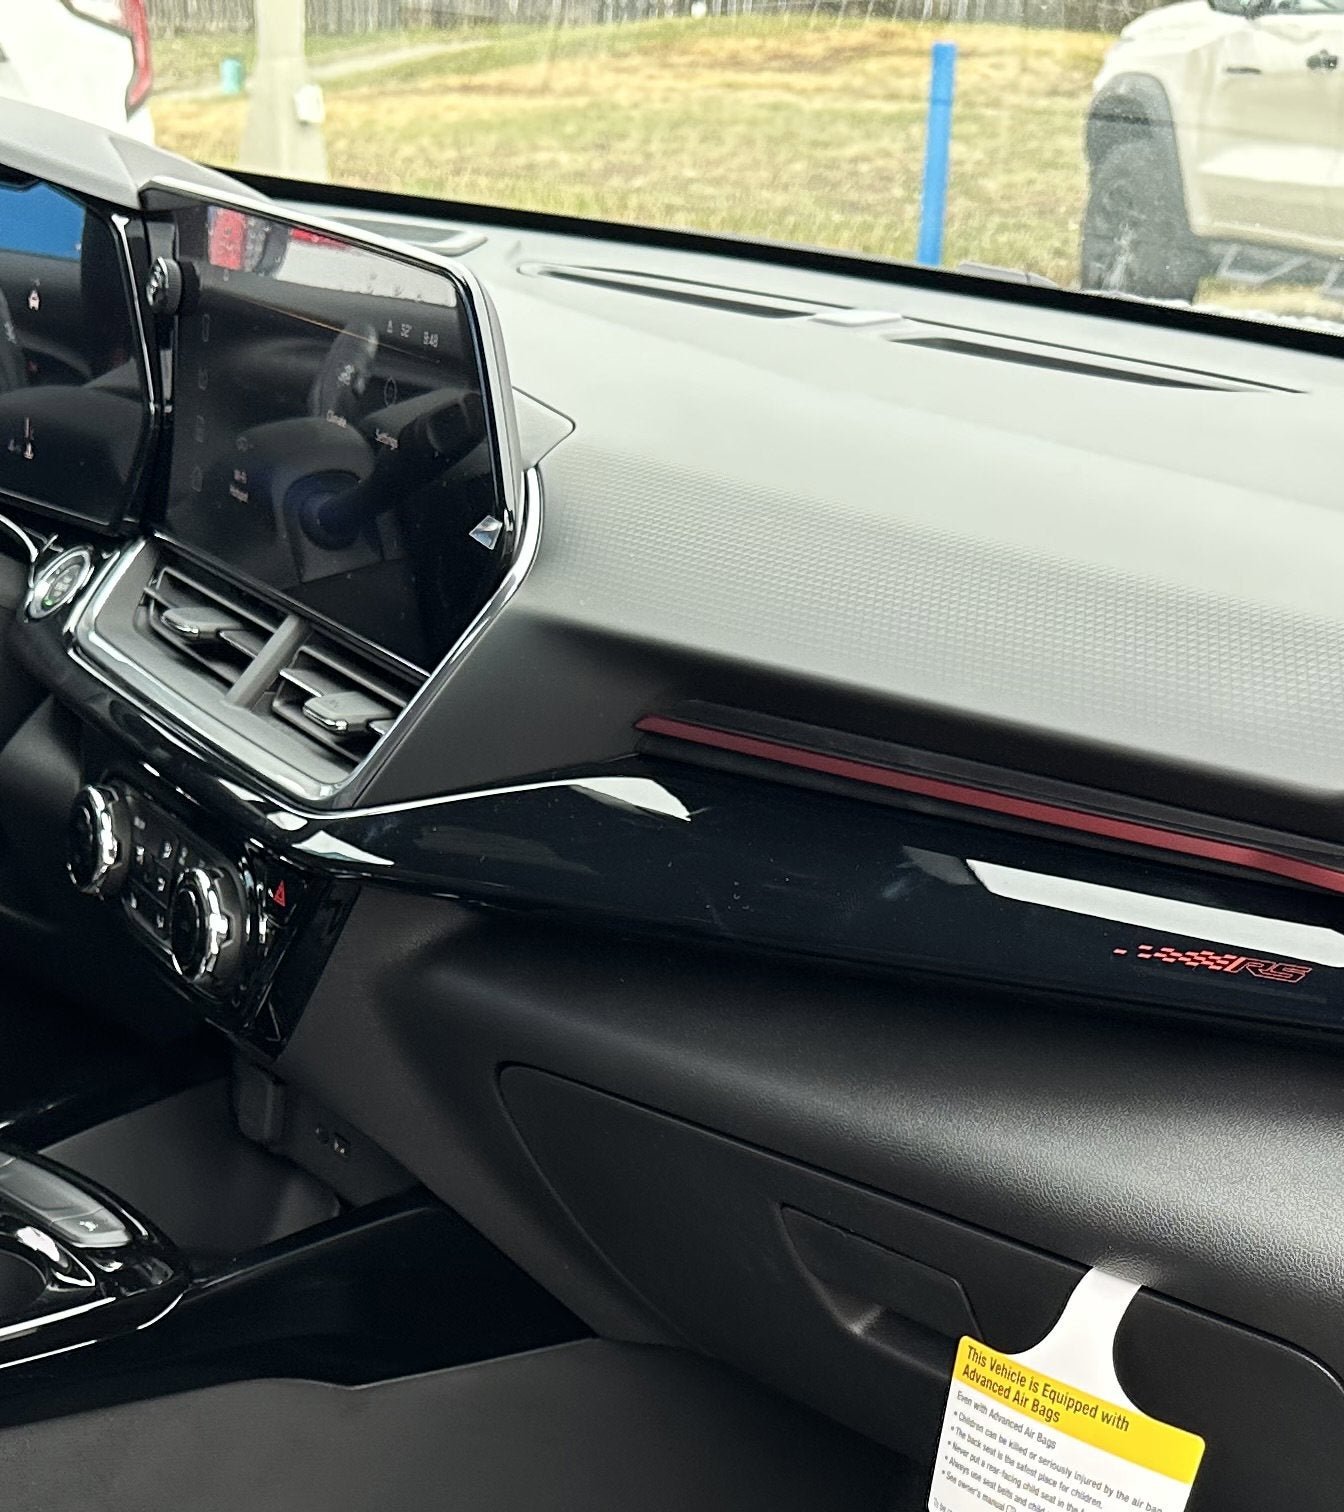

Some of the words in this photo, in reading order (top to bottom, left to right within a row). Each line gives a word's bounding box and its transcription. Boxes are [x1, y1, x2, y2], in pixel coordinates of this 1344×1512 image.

[1226, 955, 1313, 984] RS
[962, 1363, 1012, 1400] Advanced
[1012, 1389, 1029, 1408] Air
[1031, 1398, 1061, 1423] Bags
[968, 1345, 987, 1368] This
[990, 1356, 1027, 1388] Vehicle
[1029, 1376, 1040, 1393] is
[1042, 1382, 1099, 1420] Equipped
[1101, 1410, 1130, 1432] with
[957, 1390, 973, 1406] Even
[973, 1400, 988, 1414] with
[988, 1408, 1024, 1433] Advanced
[1024, 1426, 1035, 1439] Air
[1037, 1432, 1057, 1450] Bags
[1038, 1455, 1072, 1479] seriously
[1074, 1471, 1102, 1491] injured
[1103, 1484, 1114, 1498] by
[1116, 1489, 1129, 1502] the
[1131, 1497, 1144, 1508] air
[1040, 1490, 1057, 1504] seat
[1057, 1498, 1065, 1509] in
[1059, 1481, 1069, 1493] for
